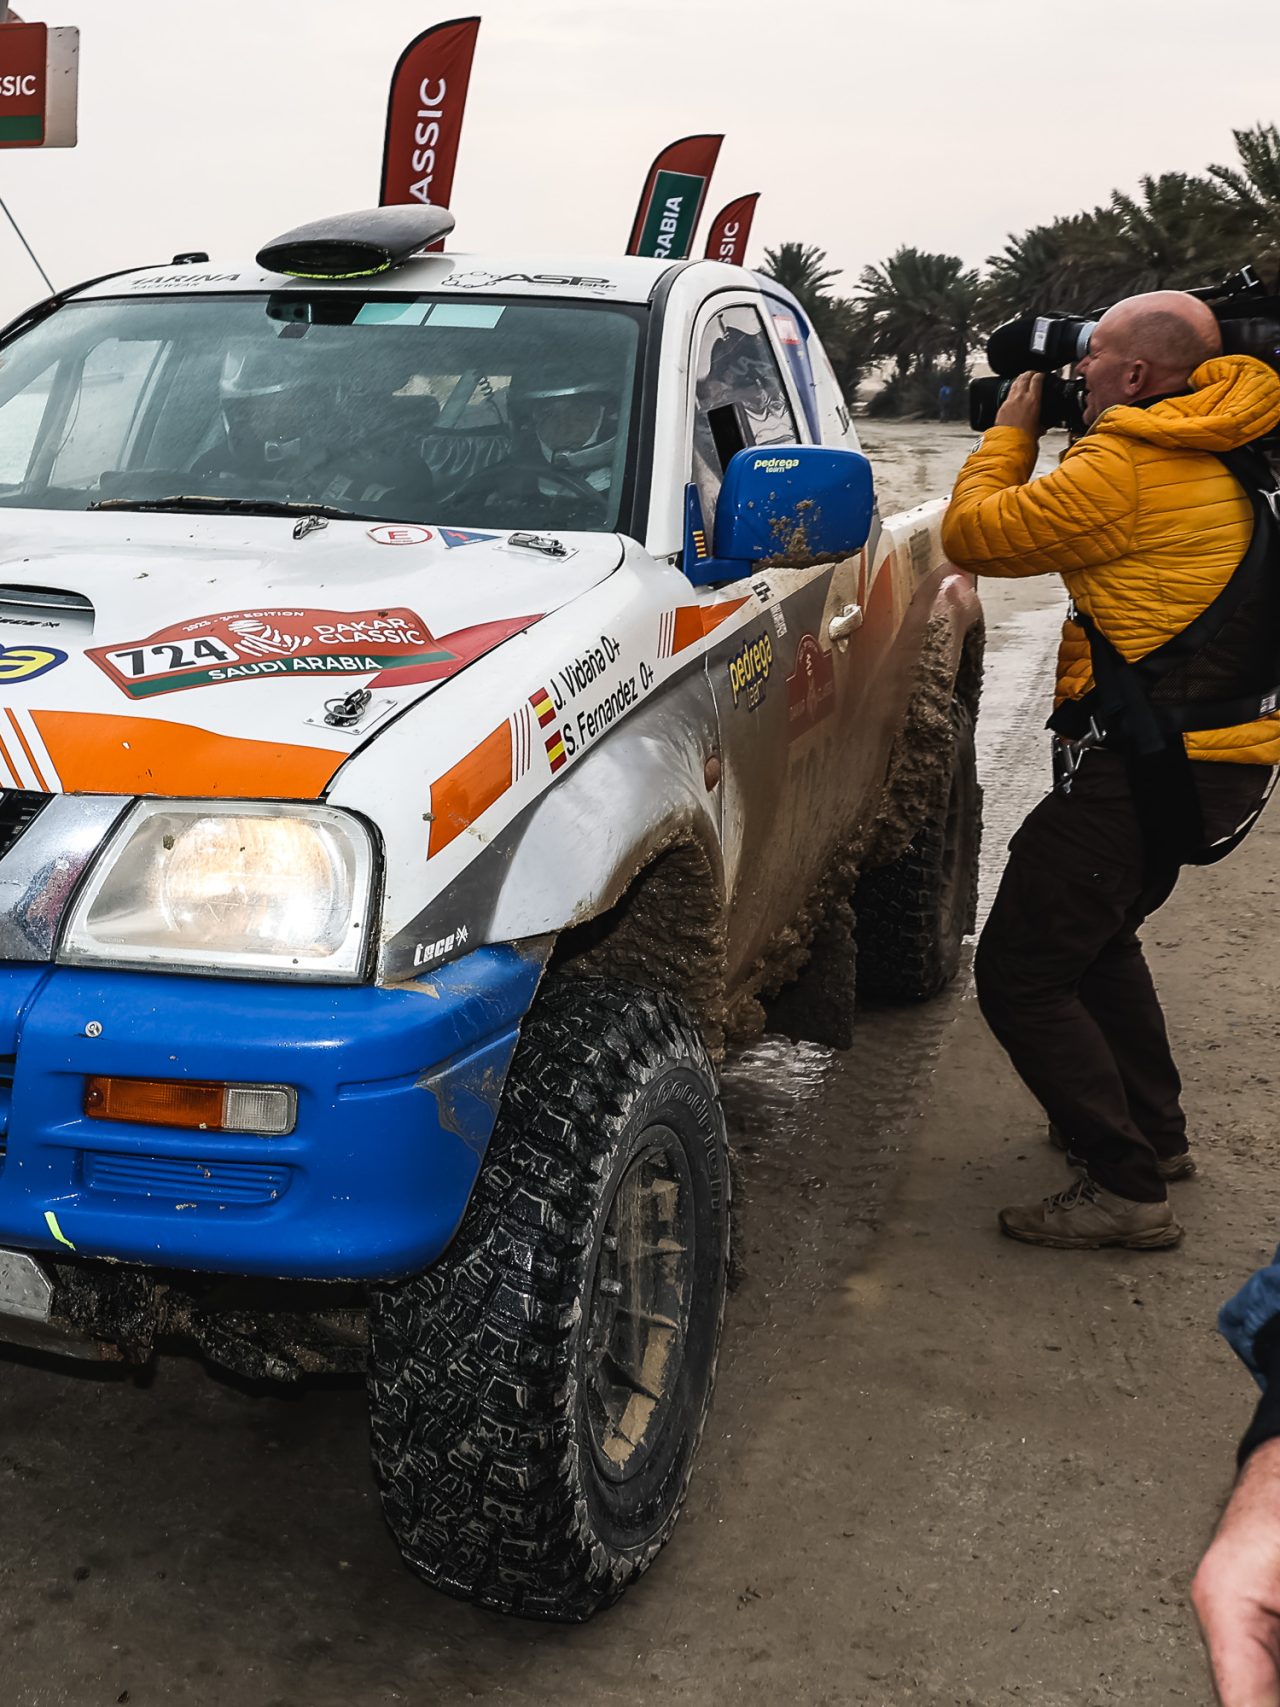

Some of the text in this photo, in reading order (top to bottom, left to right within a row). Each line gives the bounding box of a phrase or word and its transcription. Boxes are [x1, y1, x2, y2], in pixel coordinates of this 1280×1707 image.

[409, 77, 446, 204] ASSIC
[654, 196, 683, 258] RABIA
[495, 273, 610, 286] ASP
[754, 458, 799, 470] pedrega
[313, 617, 407, 634] DAKAR
[318, 629, 425, 645] CLASSIC
[116, 639, 229, 676] 724
[208, 656, 383, 680] SAUDI ARABIA
[729, 634, 772, 704] pedrega
[550, 678, 567, 710] J.
[559, 650, 606, 698] Vidaña
[562, 722, 579, 756] S.
[577, 676, 639, 745] Fernandez
